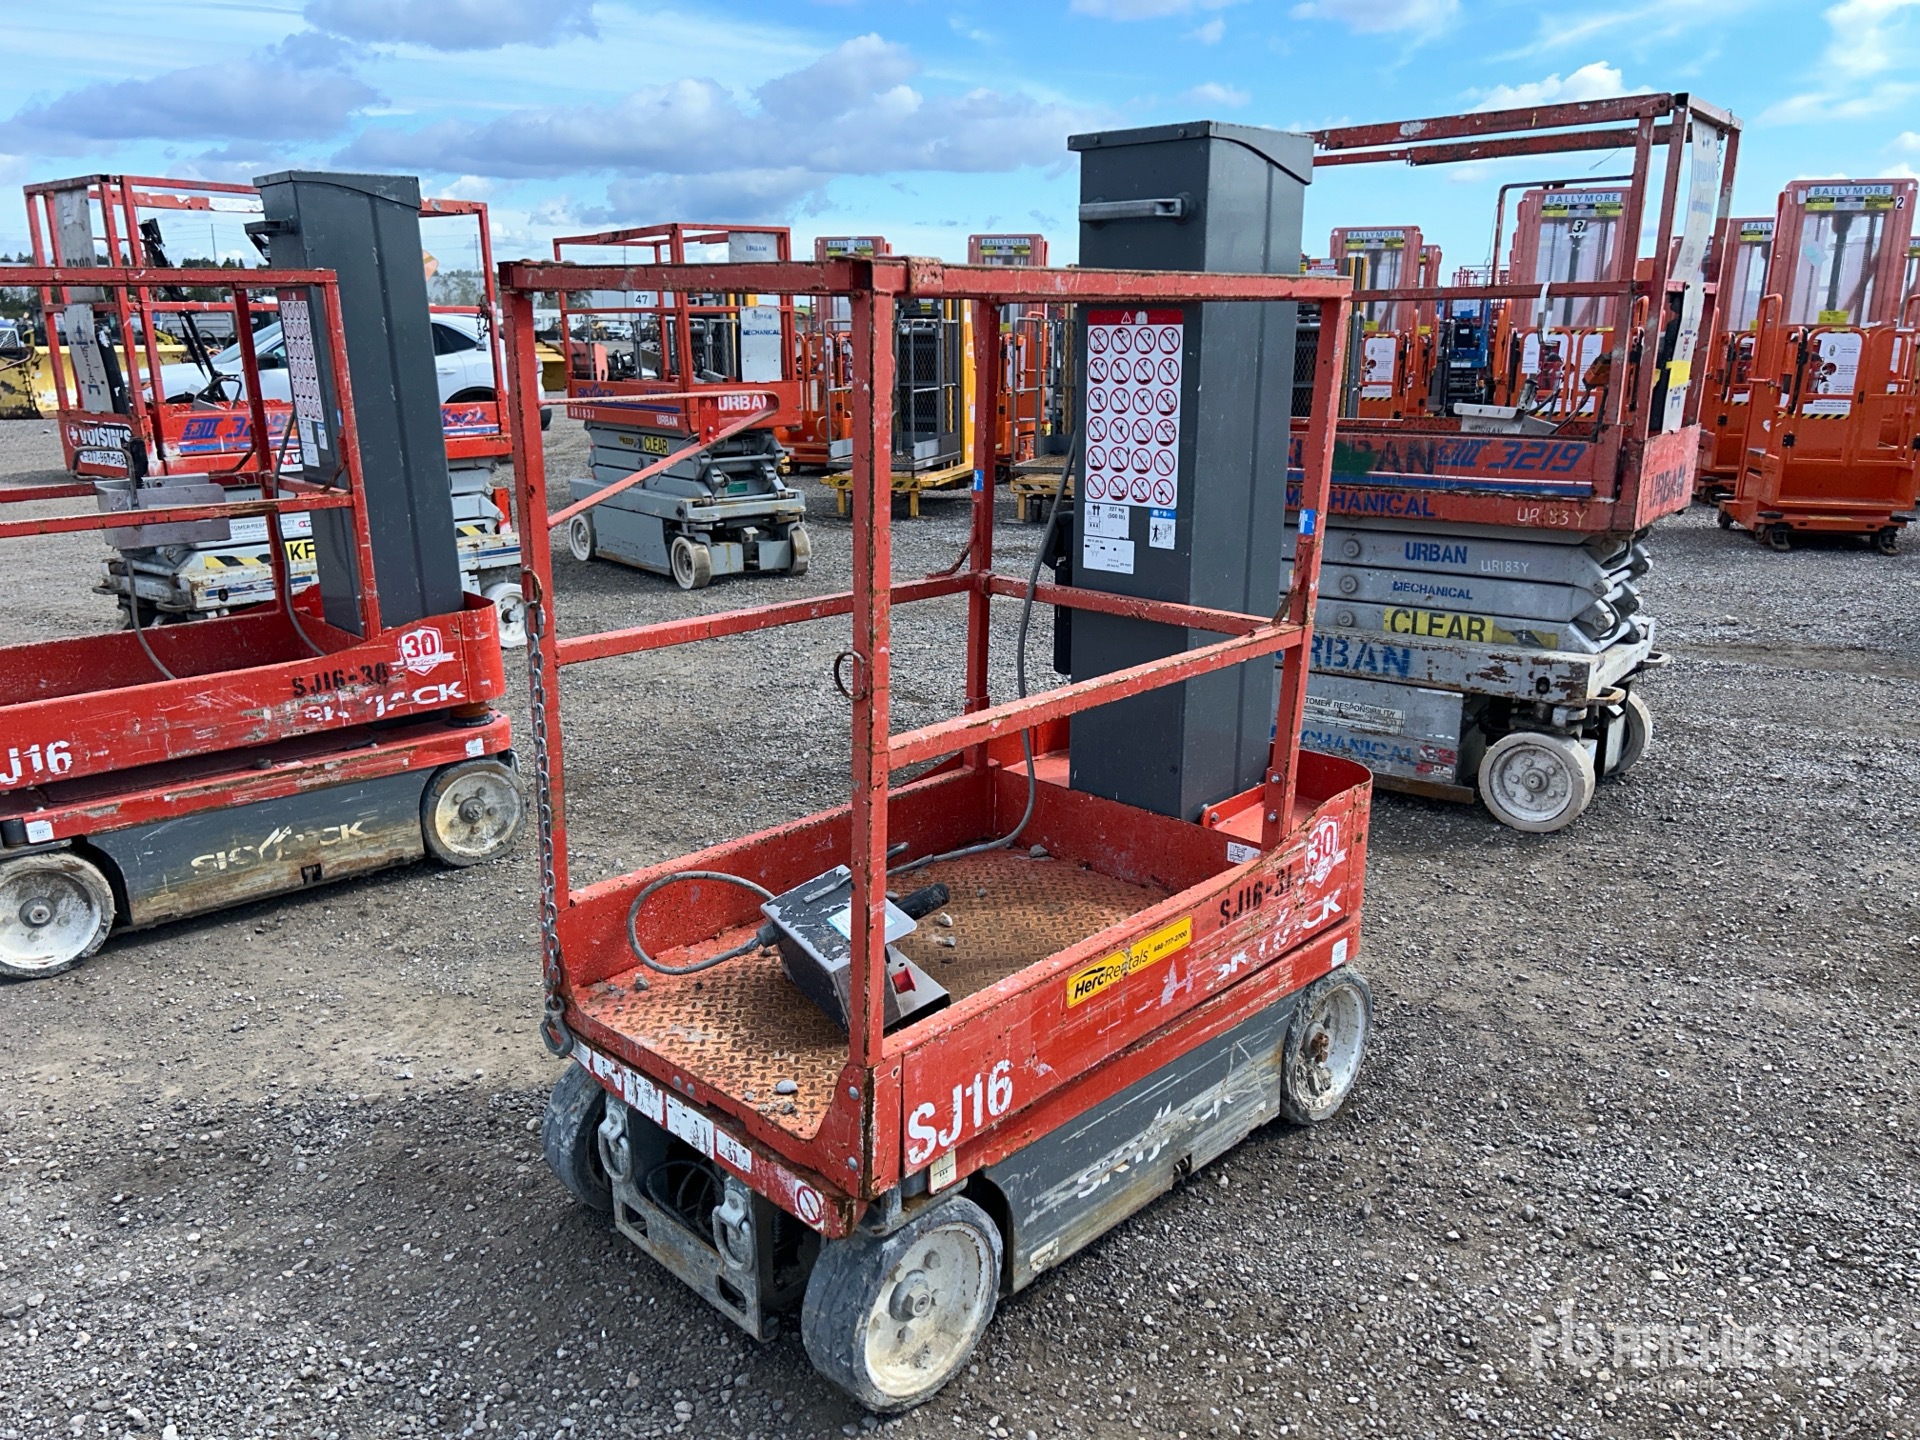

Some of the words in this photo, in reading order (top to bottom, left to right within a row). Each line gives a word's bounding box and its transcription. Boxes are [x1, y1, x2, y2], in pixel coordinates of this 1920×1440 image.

[1548, 193, 1618, 203] BALLYMORE
[1813, 186, 1888, 196] BALLYMORE
[1896, 196, 1904, 209] 2
[1349, 231, 1400, 239] BALLYMORE
[1573, 220, 1583, 233] 3
[635, 294, 648, 305] 47
[577, 383, 615, 398] SKYJACK
[717, 395, 767, 411] URBA
[656, 414, 678, 427] URBAN
[79, 427, 132, 450] VOISIN'S
[643, 436, 668, 454] CLEAR
[1489, 440, 1588, 473] 3219
[1649, 463, 1687, 509] URBAN
[1404, 541, 1468, 564] URBAN
[1480, 559, 1530, 574] UR183Y
[1392, 580, 1473, 600] MECHANICAL
[1390, 608, 1486, 643] CLEAR
[404, 632, 437, 659] 30
[291, 661, 390, 698] SJ16-30
[1307, 824, 1335, 865] 30
[1073, 949, 1149, 999] HercRentals
[1153, 930, 1188, 952] 888-777-2700
[907, 1059, 1014, 1165] SJ16
